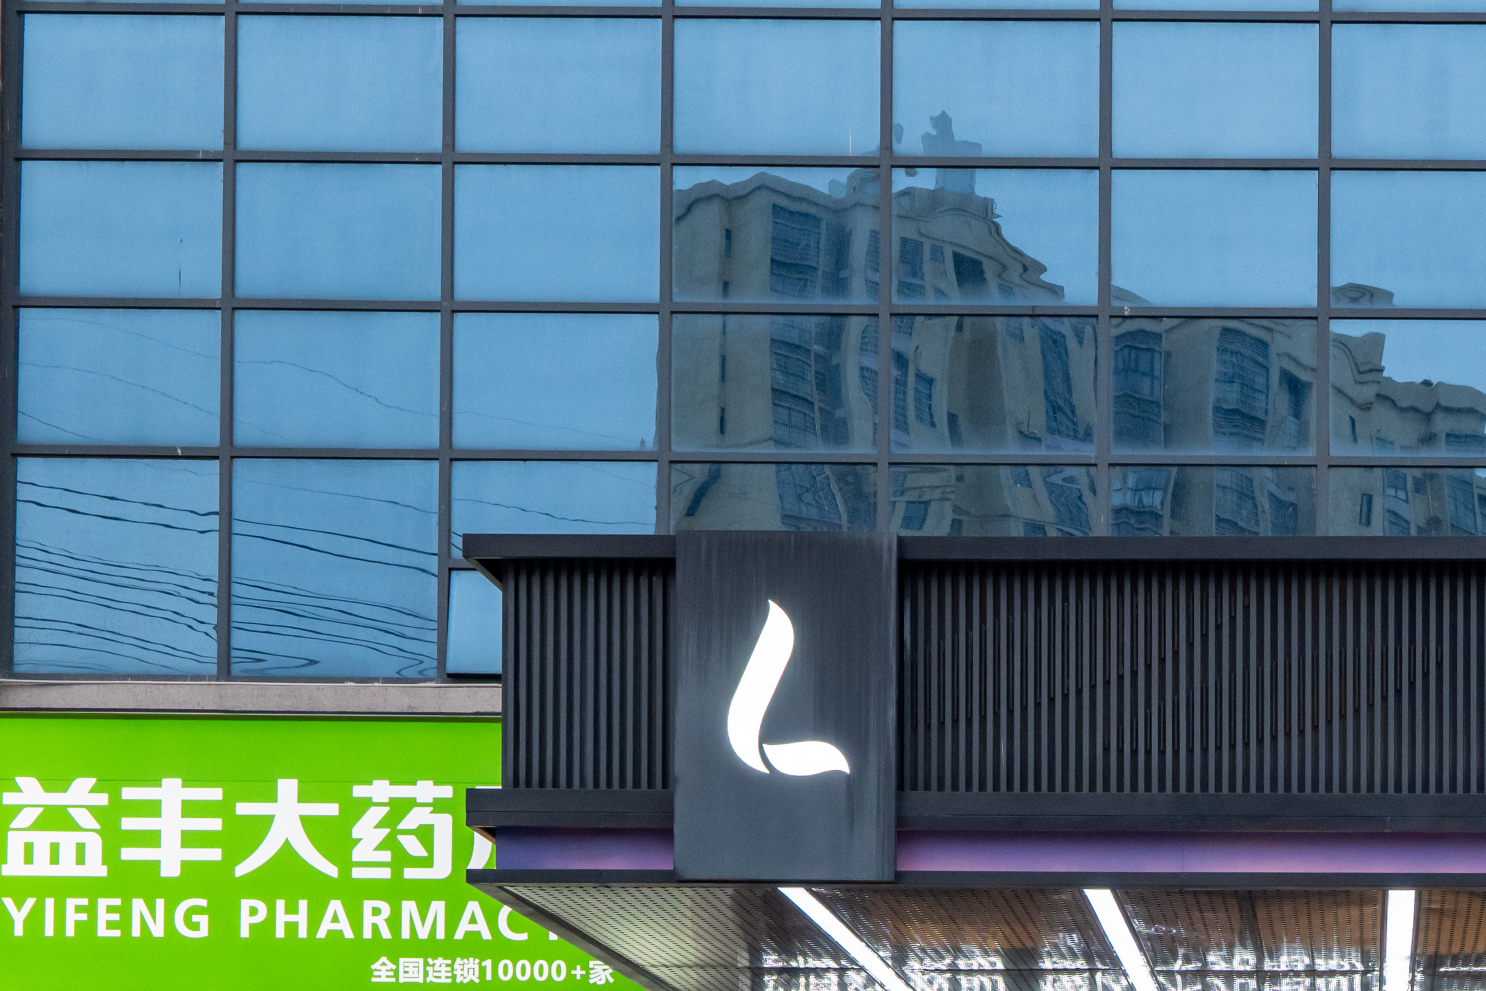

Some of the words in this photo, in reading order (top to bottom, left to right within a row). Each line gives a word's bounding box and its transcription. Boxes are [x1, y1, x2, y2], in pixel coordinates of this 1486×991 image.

[1, 777, 502, 880] 益丰大药
[1, 898, 209, 939] YIFENG
[240, 899, 558, 941] PHARMAC
[371, 957, 614, 985] 全国连锁10000+家
